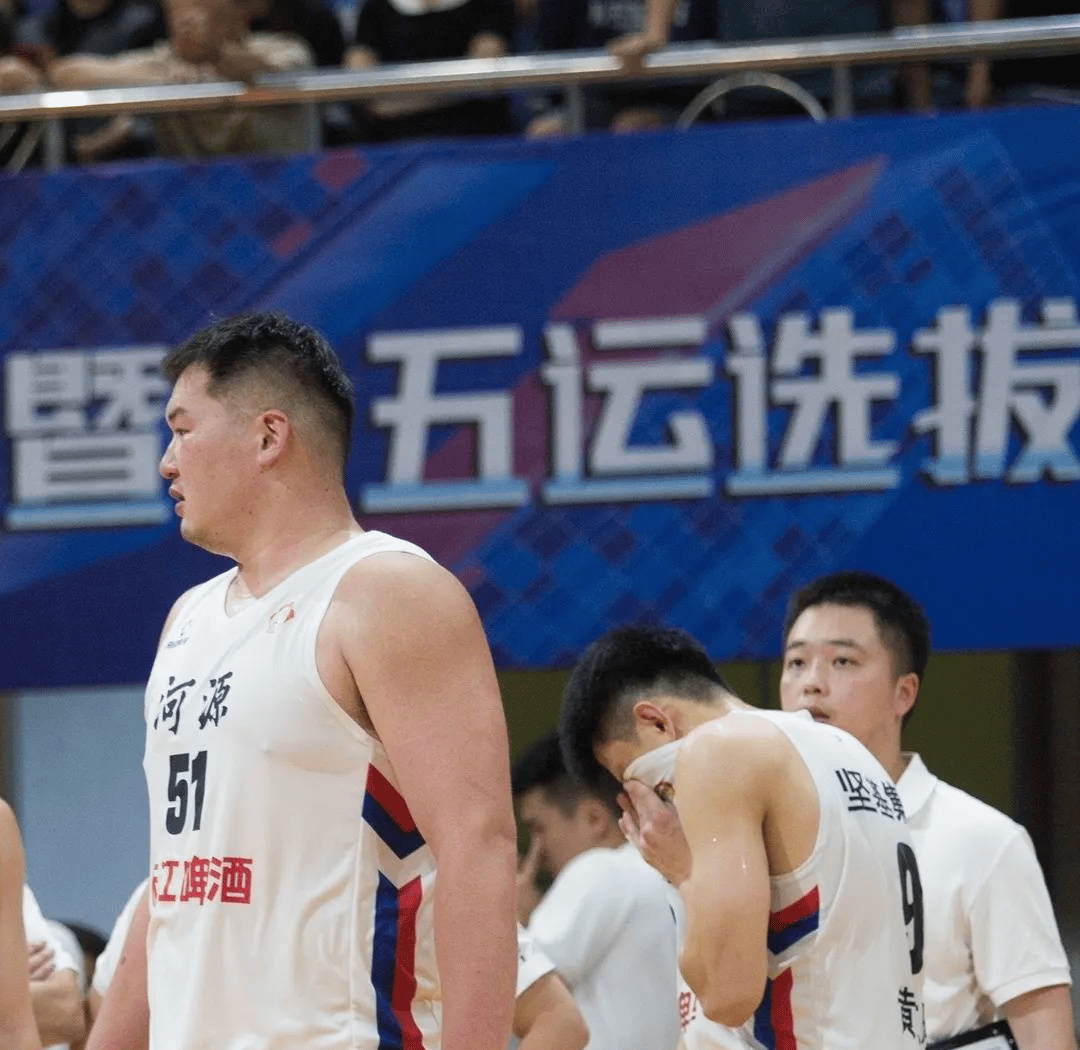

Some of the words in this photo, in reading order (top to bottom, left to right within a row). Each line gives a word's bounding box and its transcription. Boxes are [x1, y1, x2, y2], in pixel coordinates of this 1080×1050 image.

[153, 671, 234, 735] 河源
[165, 750, 208, 836] 51
[897, 842, 925, 975] 9
